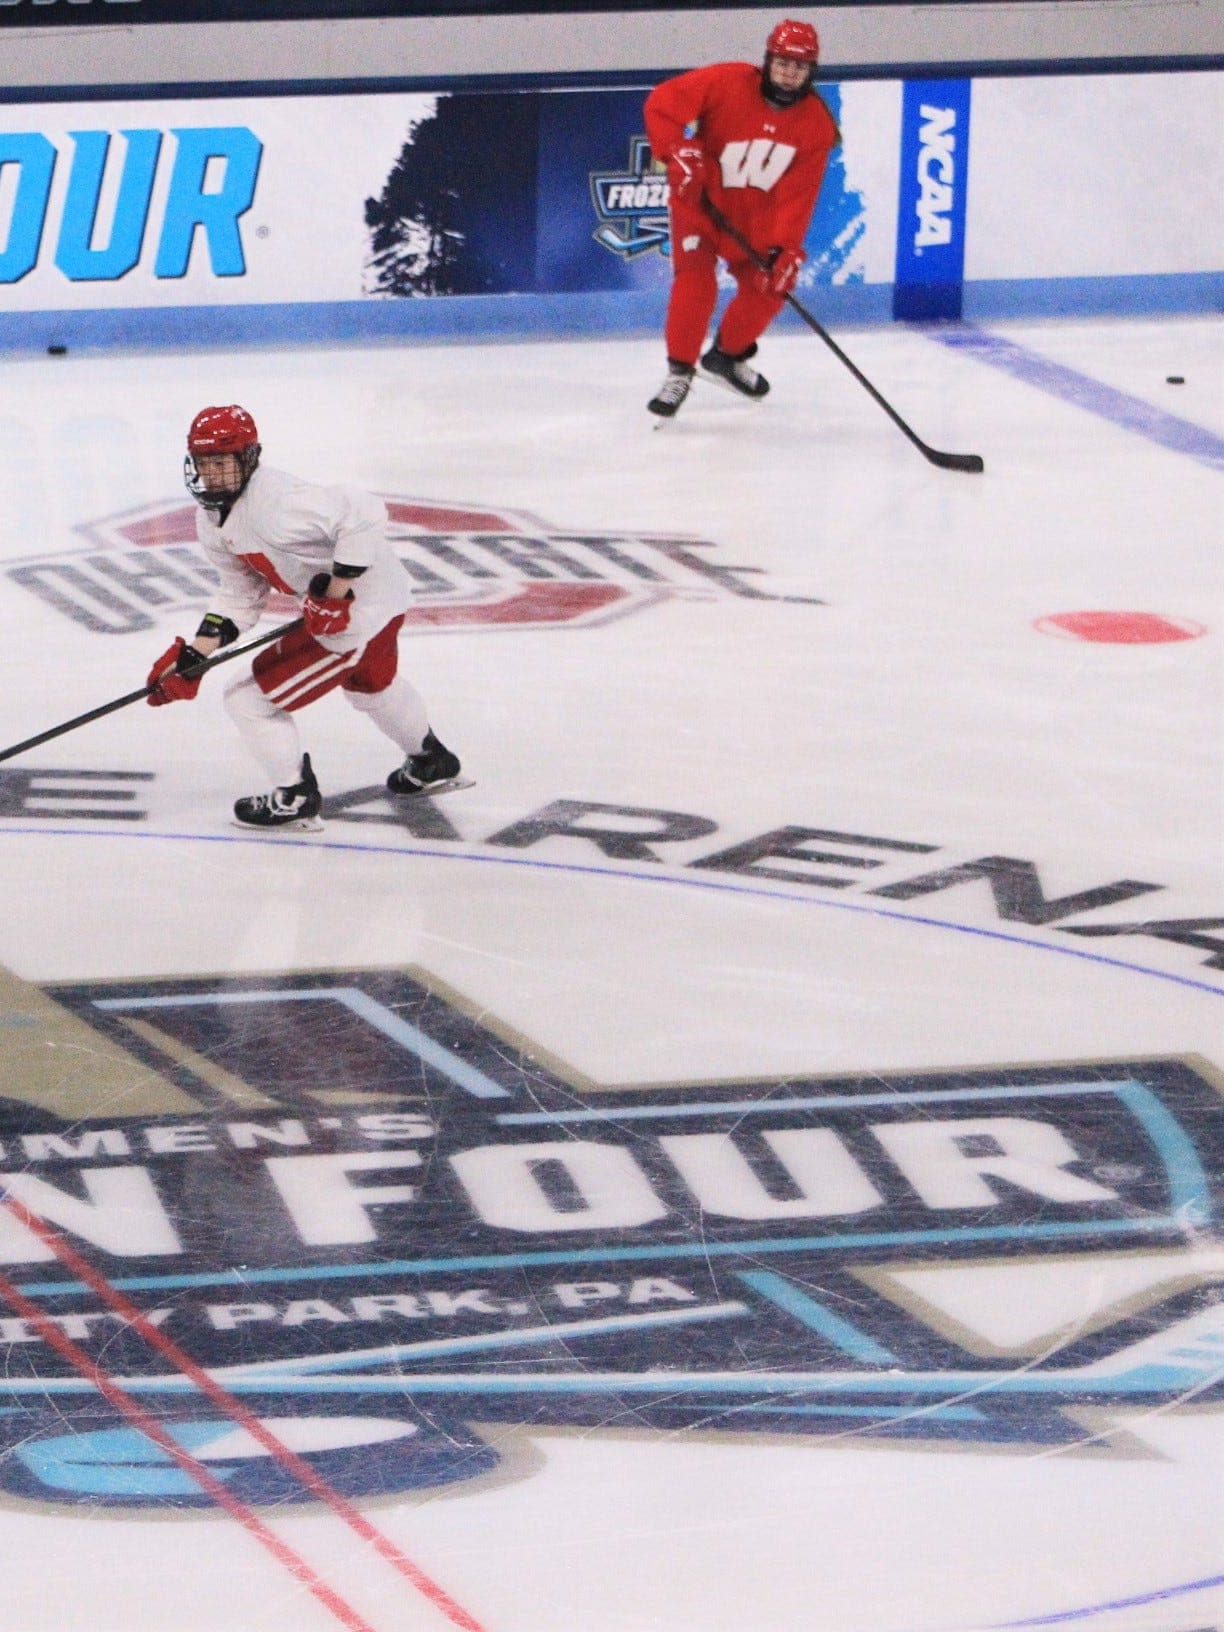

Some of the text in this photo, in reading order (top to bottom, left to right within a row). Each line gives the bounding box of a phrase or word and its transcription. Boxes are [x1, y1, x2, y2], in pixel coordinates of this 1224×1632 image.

[719, 138, 797, 193] W
[914, 103, 956, 248] NCAA
[4, 547, 222, 634] OH
[263, 1116, 1120, 1248] FOUR
[552, 1277, 698, 1308] PA
